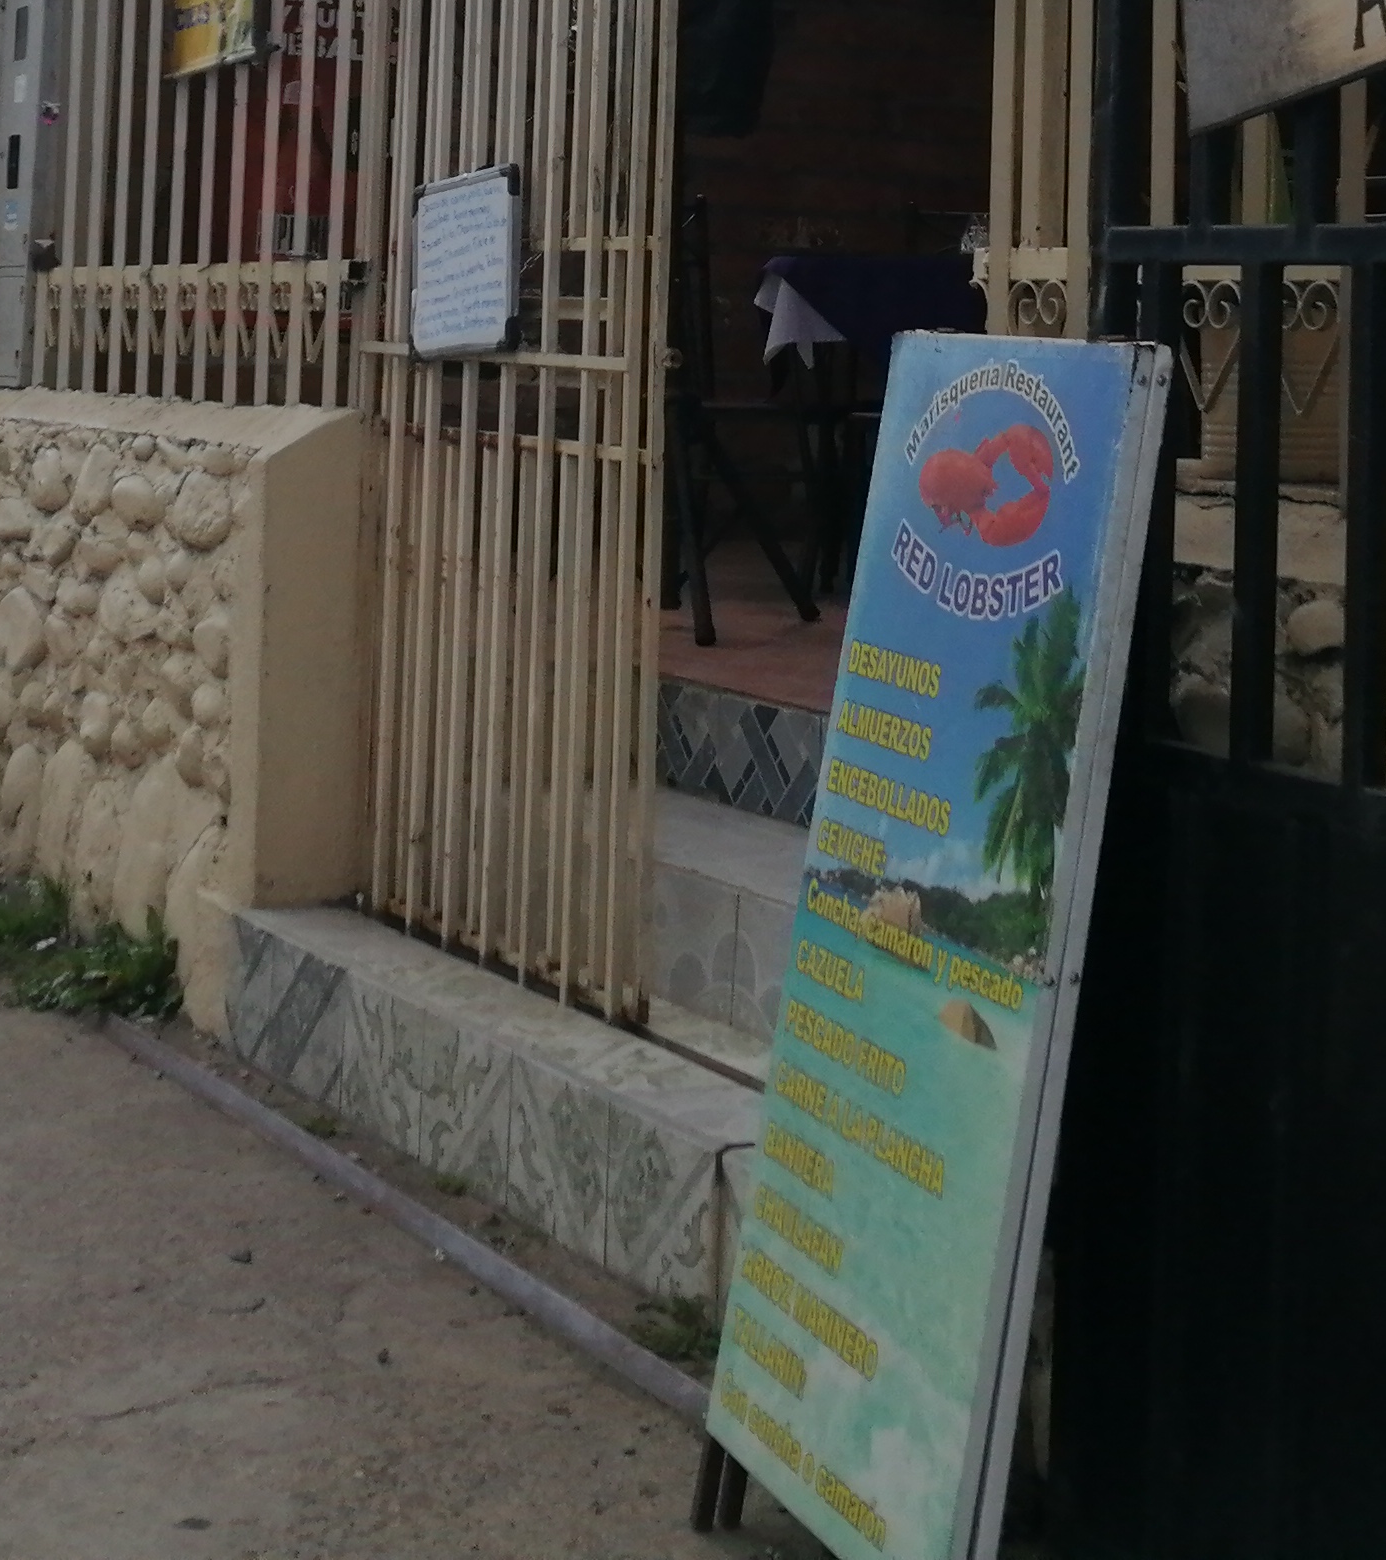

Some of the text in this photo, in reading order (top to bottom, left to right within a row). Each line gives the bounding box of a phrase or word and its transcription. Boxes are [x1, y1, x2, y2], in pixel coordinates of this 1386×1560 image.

[1004, 361, 1078, 479] Restaurant
[893, 522, 1061, 616] RED LOBSTER
[847, 639, 941, 698] DESAYUNOS
[836, 699, 932, 762] ALMUERZOS
[826, 758, 951, 836] ENCEBOLLADOS
[817, 818, 887, 877] CEVICHE:
[796, 940, 864, 1002] CAZUELA
[934, 948, 948, 985] y
[948, 956, 1024, 1012] pescado
[785, 998, 906, 1096] PESCADO FRITO
[764, 1121, 834, 1200] BANDERA
[775, 1058, 944, 1198] CARNE A LA PLANCHA
[742, 1248, 879, 1382] ARROZ MARINERO
[802, 1451, 815, 1485] o
